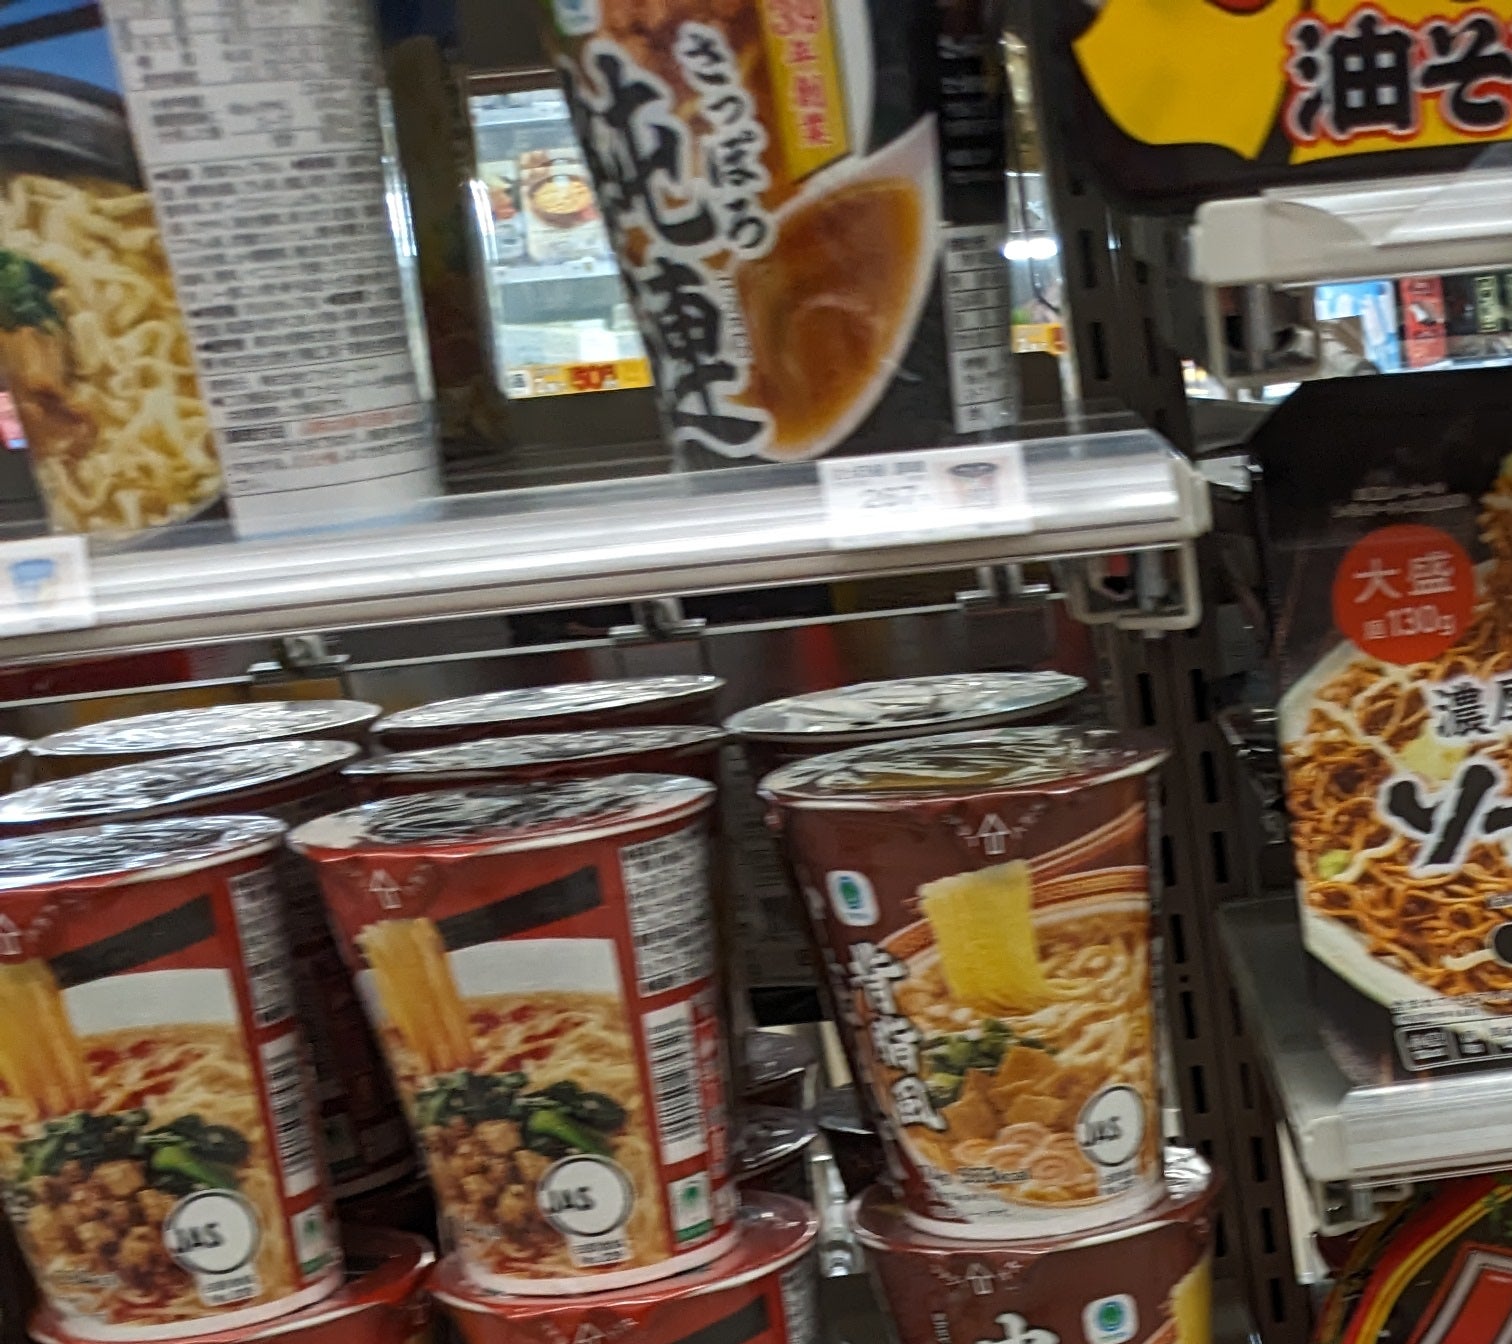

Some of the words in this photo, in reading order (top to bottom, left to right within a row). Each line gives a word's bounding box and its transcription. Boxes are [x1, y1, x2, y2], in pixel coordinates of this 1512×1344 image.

[683, 33, 768, 248] さっぽろ
[1355, 549, 1456, 600] 大盛
